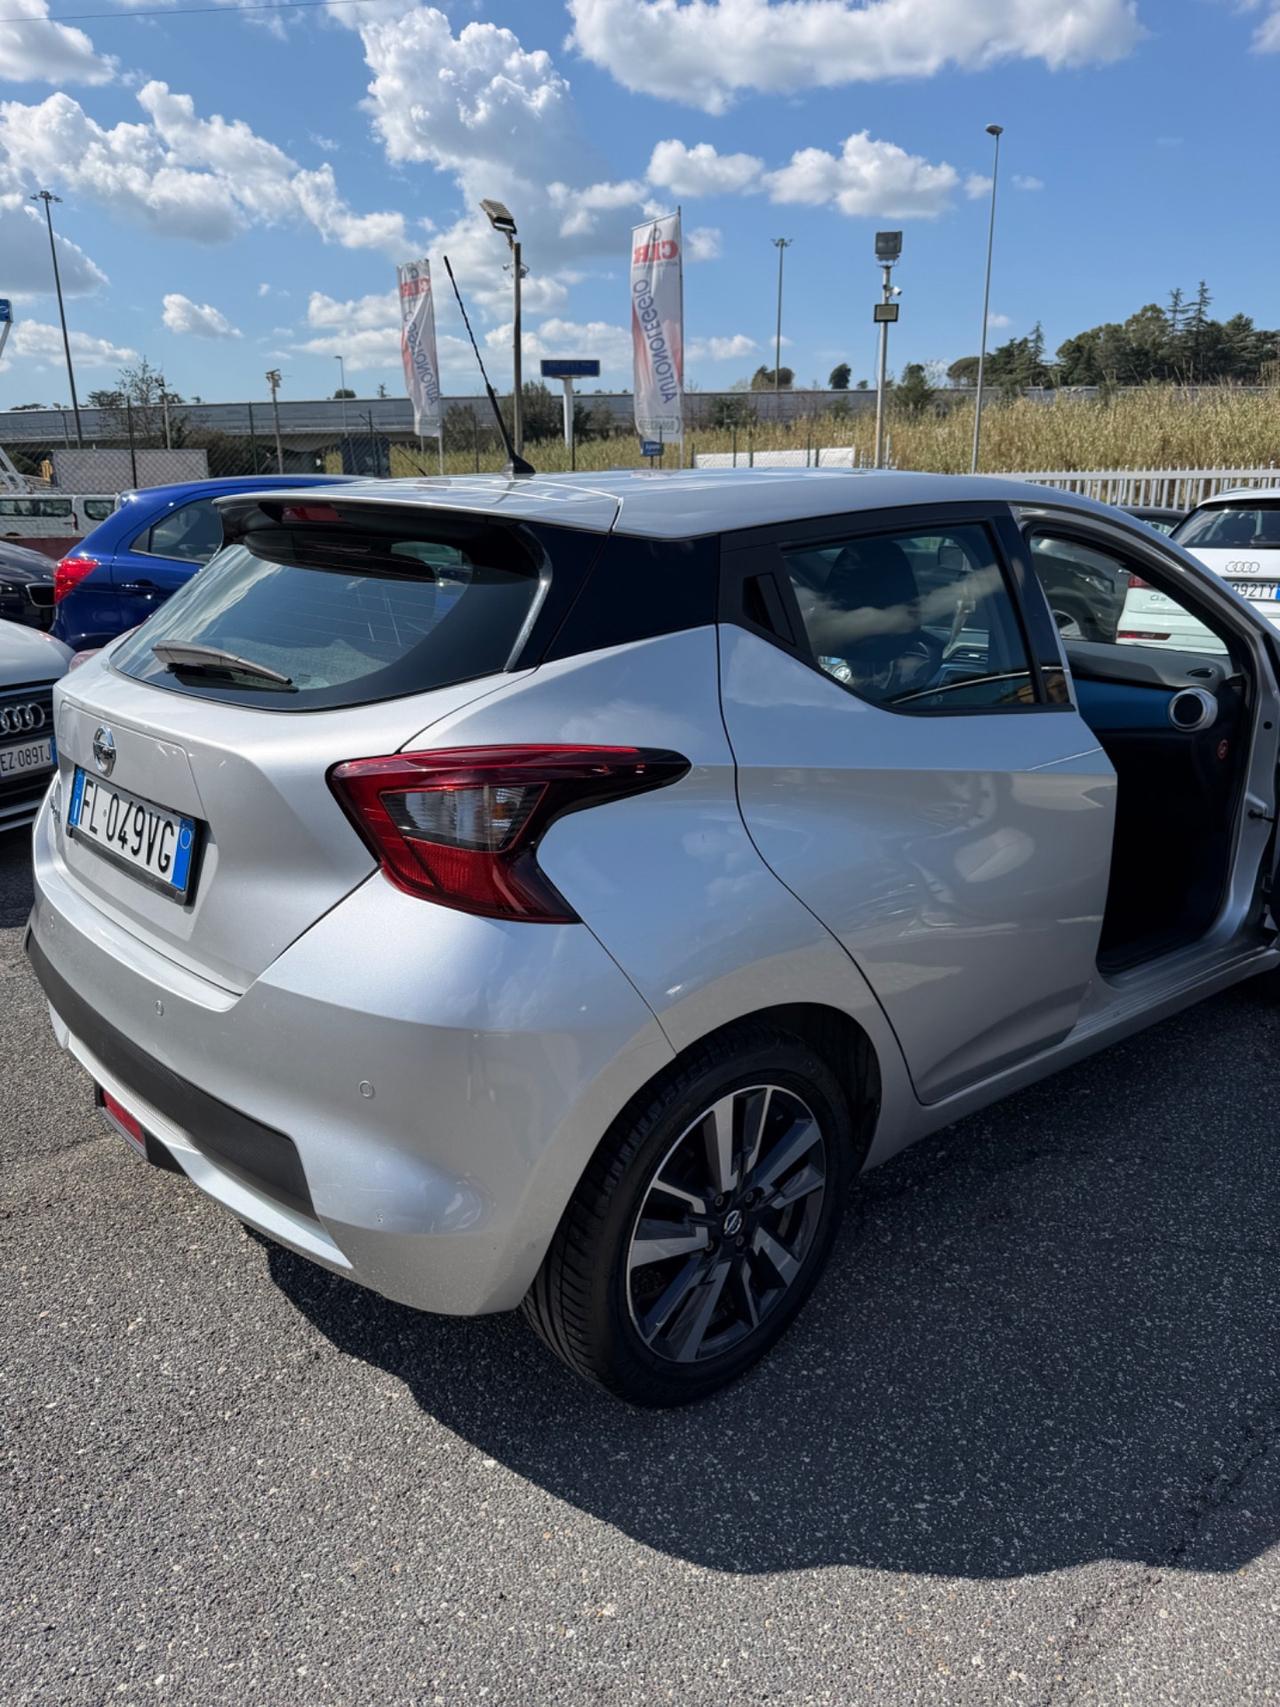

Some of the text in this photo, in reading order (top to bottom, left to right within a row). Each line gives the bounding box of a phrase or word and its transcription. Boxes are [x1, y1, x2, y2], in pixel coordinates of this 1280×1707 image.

[1, 743, 51, 772] EZ 089TJ
[79, 778, 175, 874] FL 049VG
